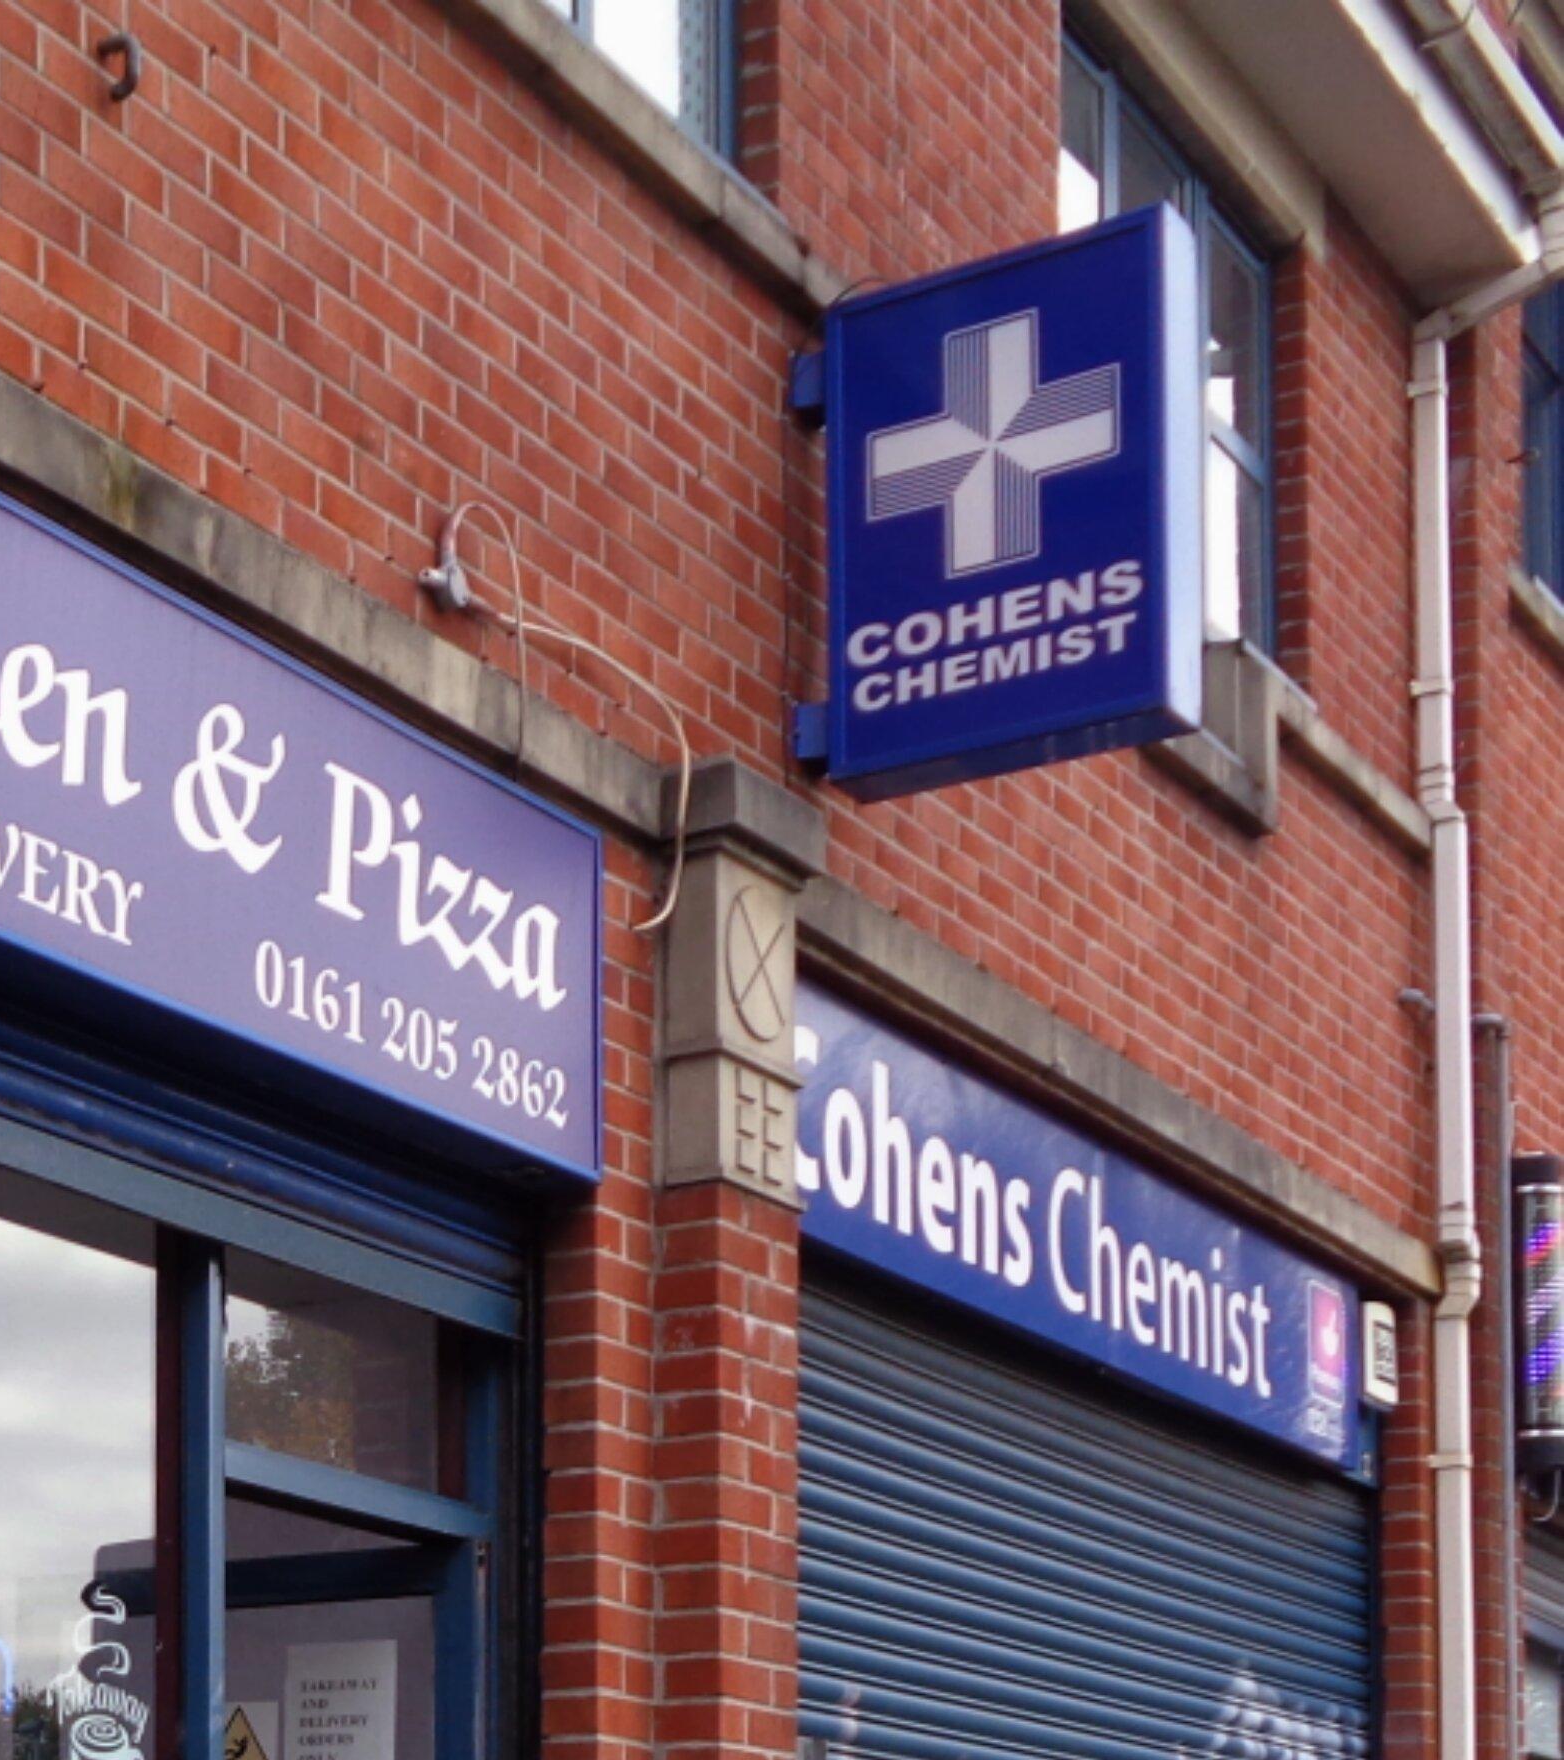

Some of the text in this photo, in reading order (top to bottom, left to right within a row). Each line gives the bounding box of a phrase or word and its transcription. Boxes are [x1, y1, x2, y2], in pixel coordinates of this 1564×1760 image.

[846, 559, 1143, 668] COHENS
[852, 612, 1137, 712] CHEMIST
[173, 703, 285, 874] &
[316, 761, 566, 1011] Pizza
[255, 940, 567, 1129] 0161 205 2862
[1048, 1167, 1272, 1397] Chemist
[299, 1714, 369, 1728] DELIVERY
